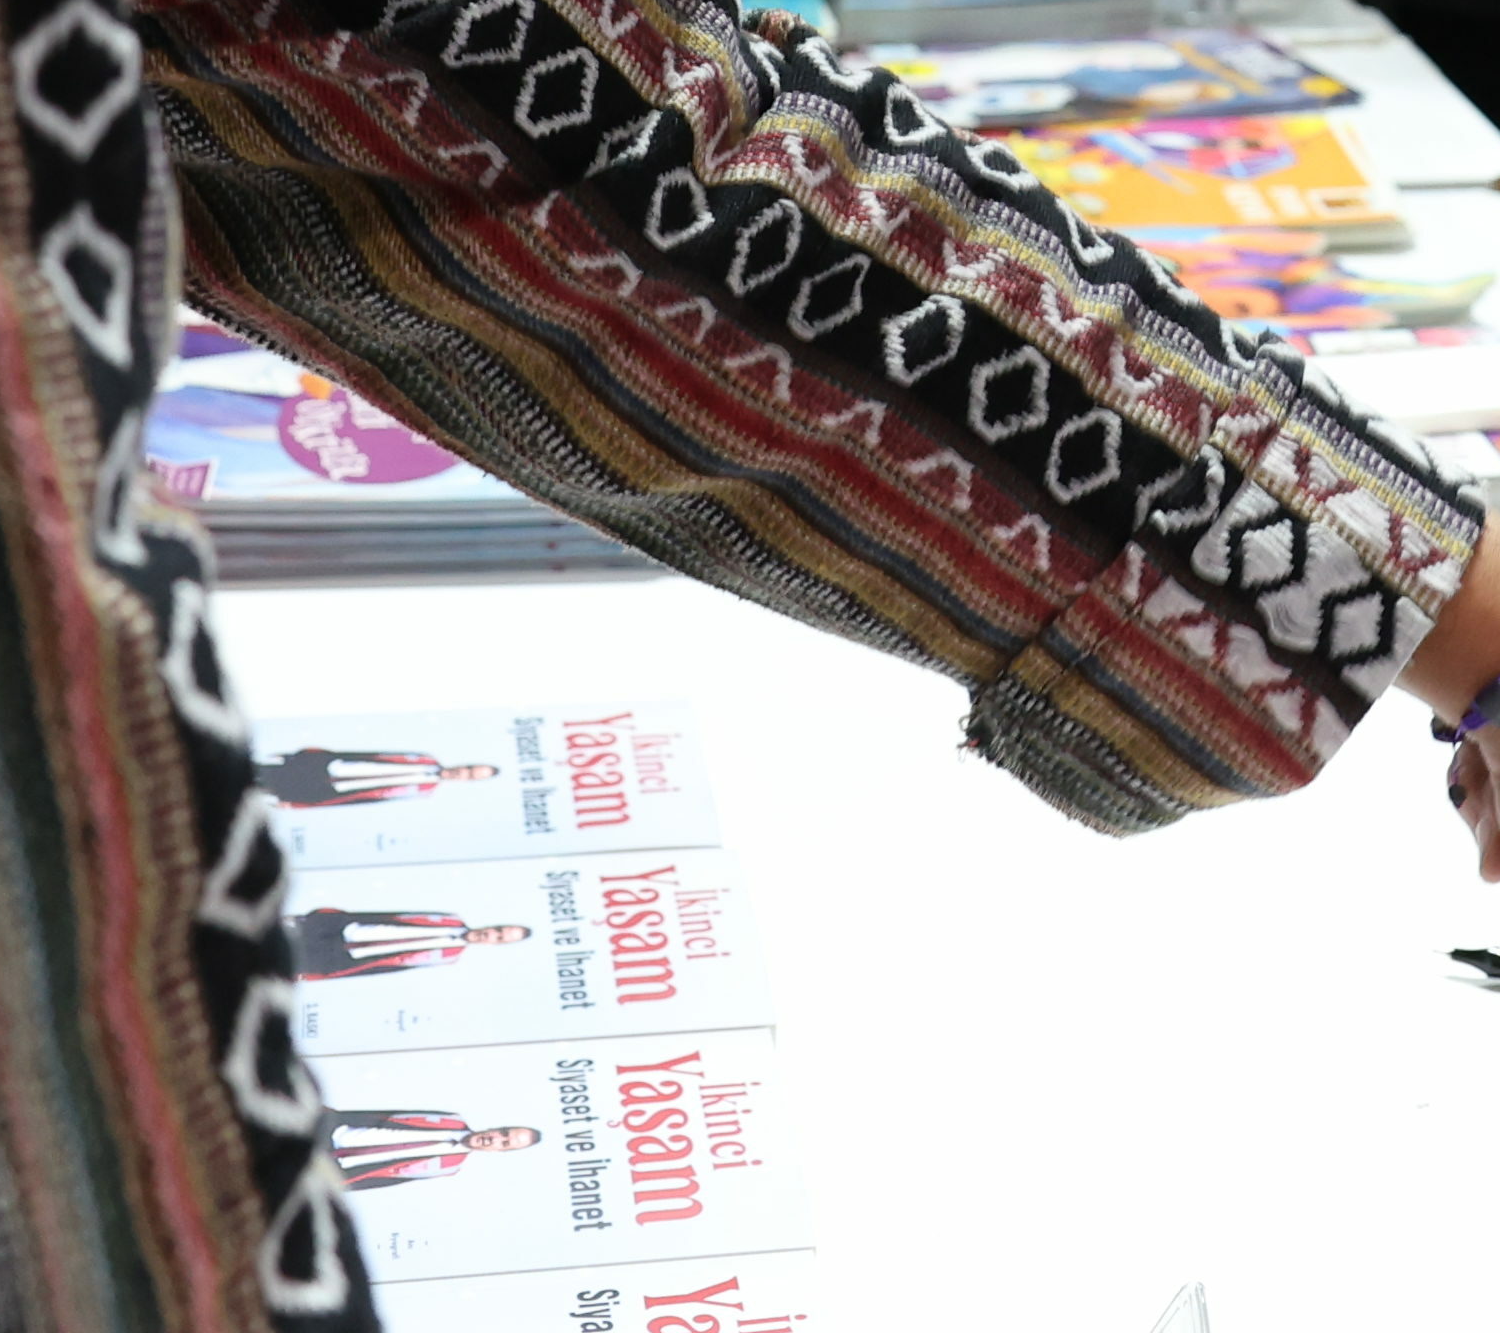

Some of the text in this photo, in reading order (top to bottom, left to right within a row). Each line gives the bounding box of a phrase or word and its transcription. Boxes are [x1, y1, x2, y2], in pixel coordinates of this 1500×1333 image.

[554, 711, 637, 830] Yaşam
[630, 732, 682, 795] İkinci
[539, 869, 597, 1011] Siyaset ve İhanet
[591, 864, 681, 1006] Yaşam
[674, 887, 732, 961] İkinci
[549, 1058, 614, 1233] Siyaset ve İhanet
[606, 1049, 706, 1226] Yaşam
[699, 1081, 764, 1171] İkinci
